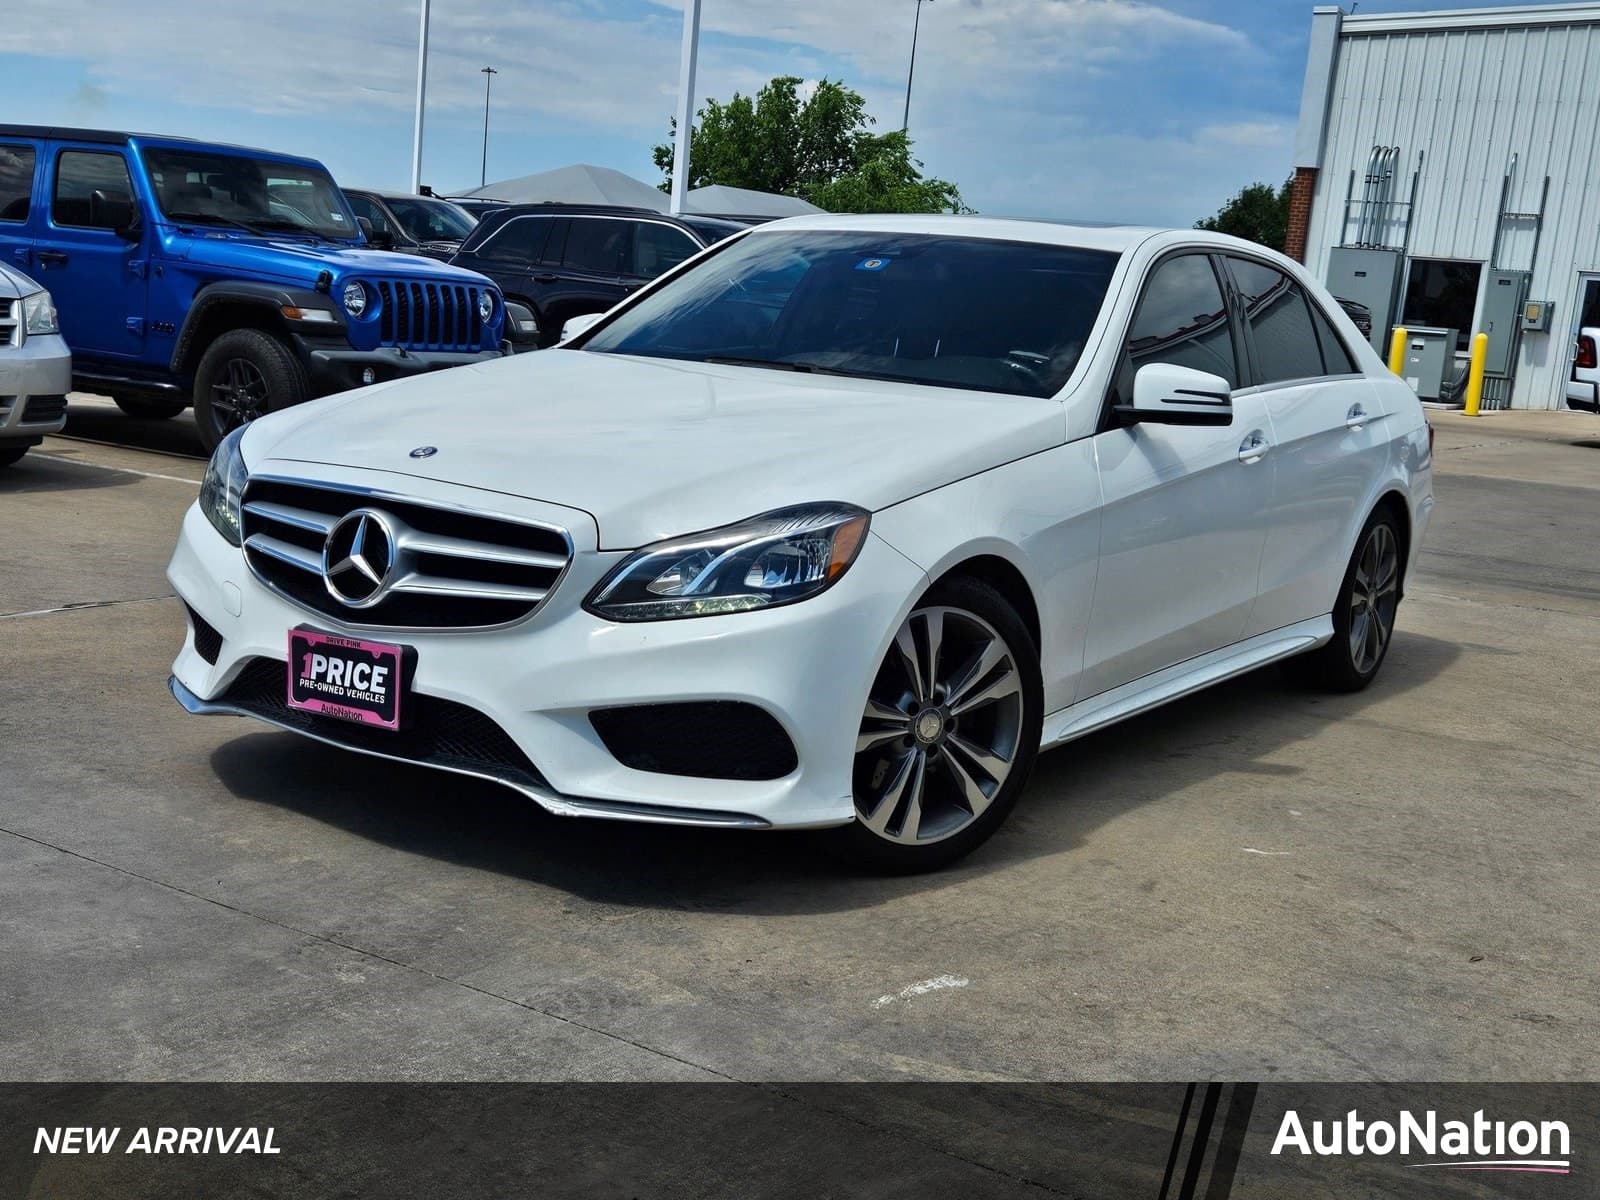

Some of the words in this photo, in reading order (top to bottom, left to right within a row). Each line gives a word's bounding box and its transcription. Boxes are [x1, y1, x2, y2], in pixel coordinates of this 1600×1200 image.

[326, 636, 345, 647] DRIVE
[346, 640, 361, 649] PINK
[301, 652, 388, 694] 1PRICE
[299, 678, 345, 696] PRE-OWNED
[346, 688, 385, 704] VEHICLES
[320, 703, 363, 720] AutoNation
